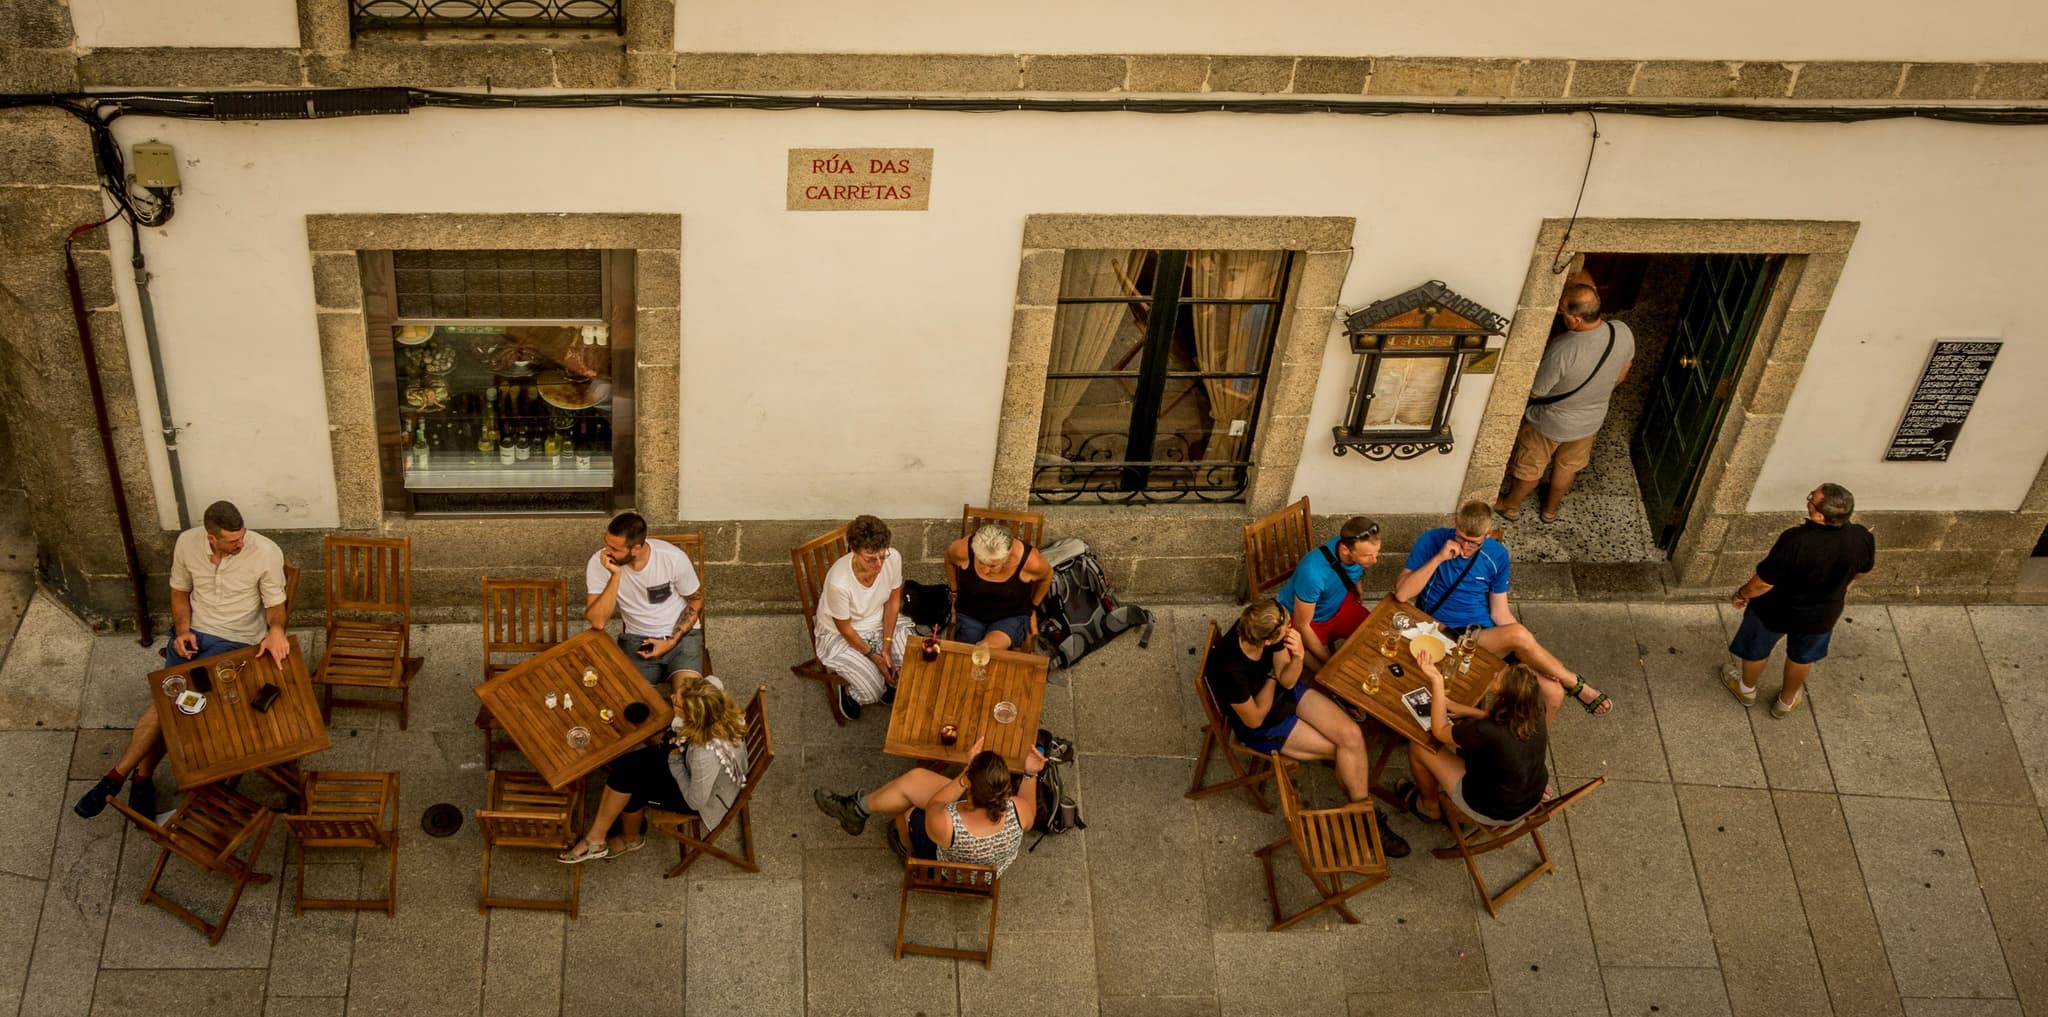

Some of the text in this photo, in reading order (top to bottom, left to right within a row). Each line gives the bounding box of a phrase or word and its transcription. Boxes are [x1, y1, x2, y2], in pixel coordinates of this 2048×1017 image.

[812, 153, 910, 174] RÚA DAS
[805, 185, 912, 200] CARRETAS
